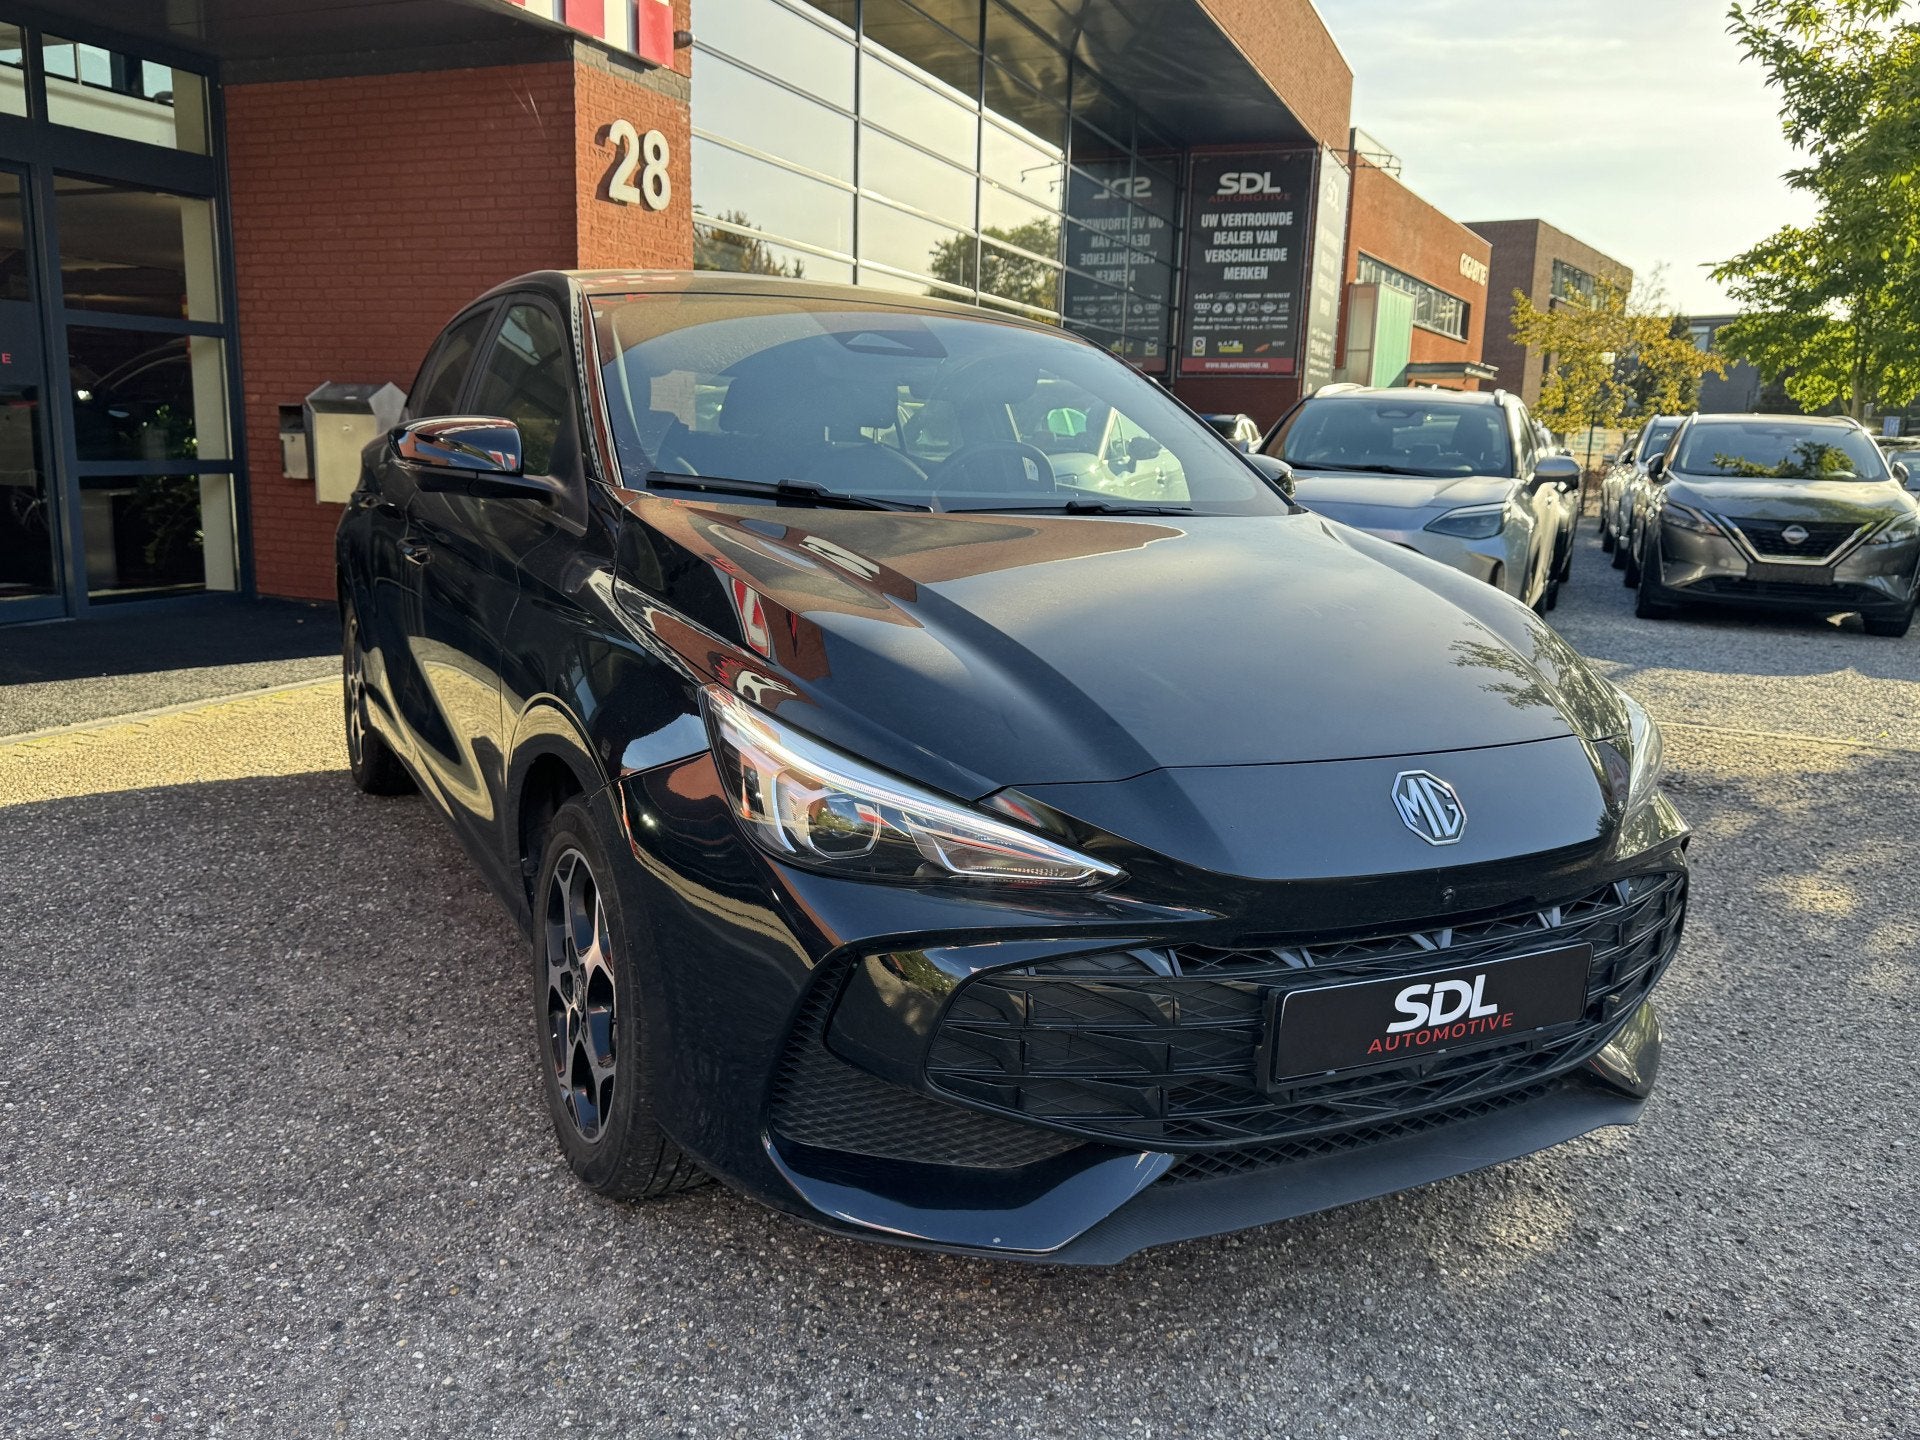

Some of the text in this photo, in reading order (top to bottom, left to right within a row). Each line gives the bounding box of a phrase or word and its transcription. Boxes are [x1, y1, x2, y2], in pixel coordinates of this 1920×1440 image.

[608, 118, 672, 211] 28
[1216, 171, 1281, 195] SDL
[1208, 193, 1292, 204] AUTOMOTIVE
[1201, 211, 1293, 228] UW VERTROUWDE
[1213, 230, 1278, 245] DEALER VAN
[1204, 247, 1288, 263] VERSCHILLENDE
[1223, 266, 1268, 281] MERKEN
[1398, 777, 1462, 838] MG
[1386, 973, 1498, 1034] SDL
[1367, 1012, 1515, 1055] AUTOMOTIVE
